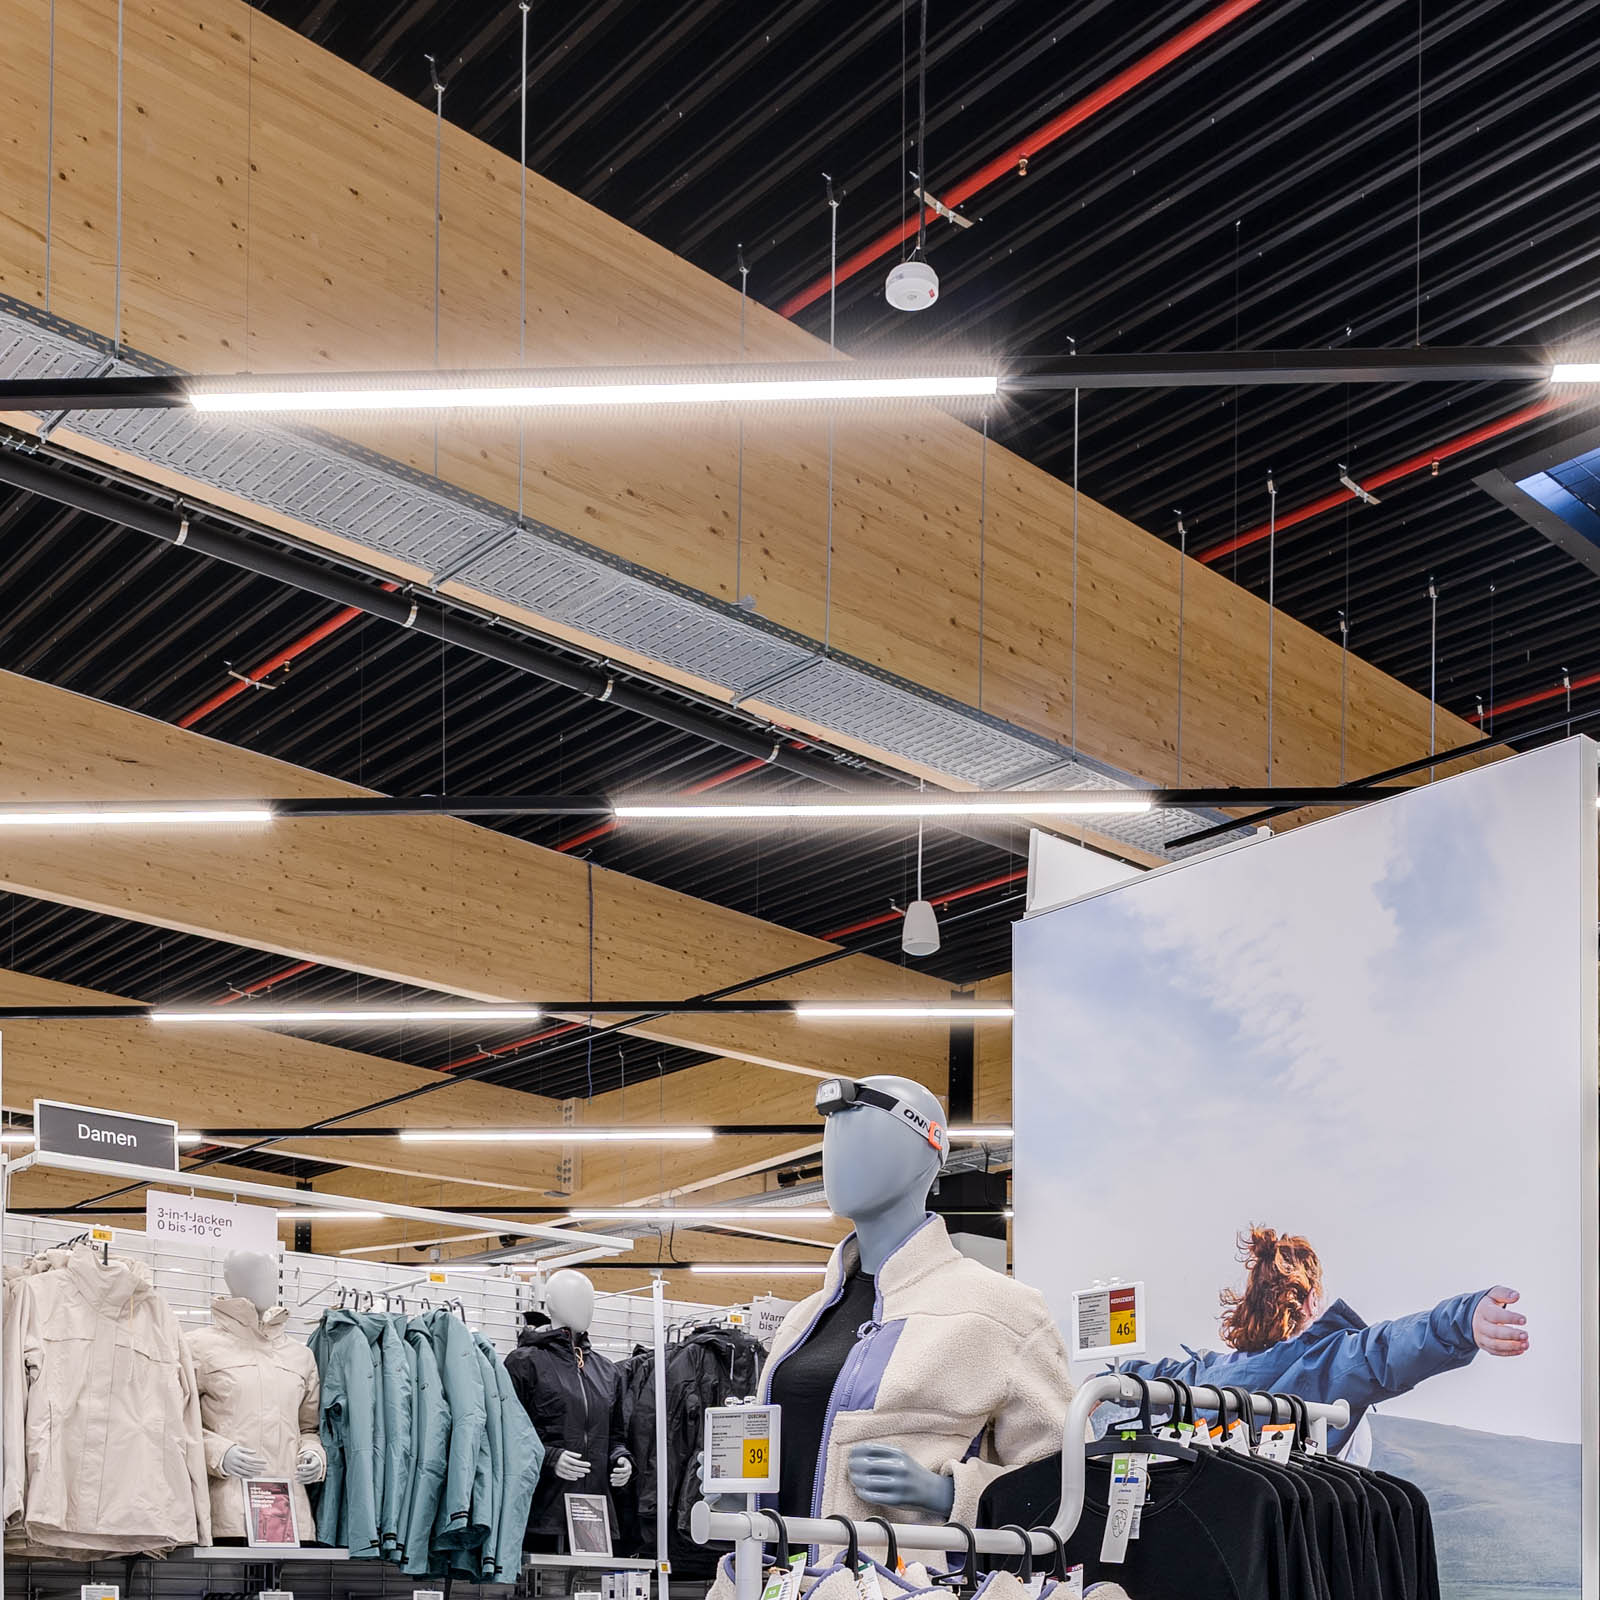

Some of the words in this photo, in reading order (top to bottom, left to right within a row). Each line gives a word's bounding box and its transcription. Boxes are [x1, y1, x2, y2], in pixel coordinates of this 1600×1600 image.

[78, 1123, 137, 1147] Damen
[157, 1208, 233, 1227] 3-in-1-Jacken
[157, 1221, 165, 1230] 0
[168, 1222, 186, 1233] bis
[188, 1225, 206, 1235] -10
[208, 1226, 222, 1238] °C
[759, 1321, 773, 1331] bis
[1116, 1322, 1130, 1336] 46
[749, 1448, 763, 1464] 39
